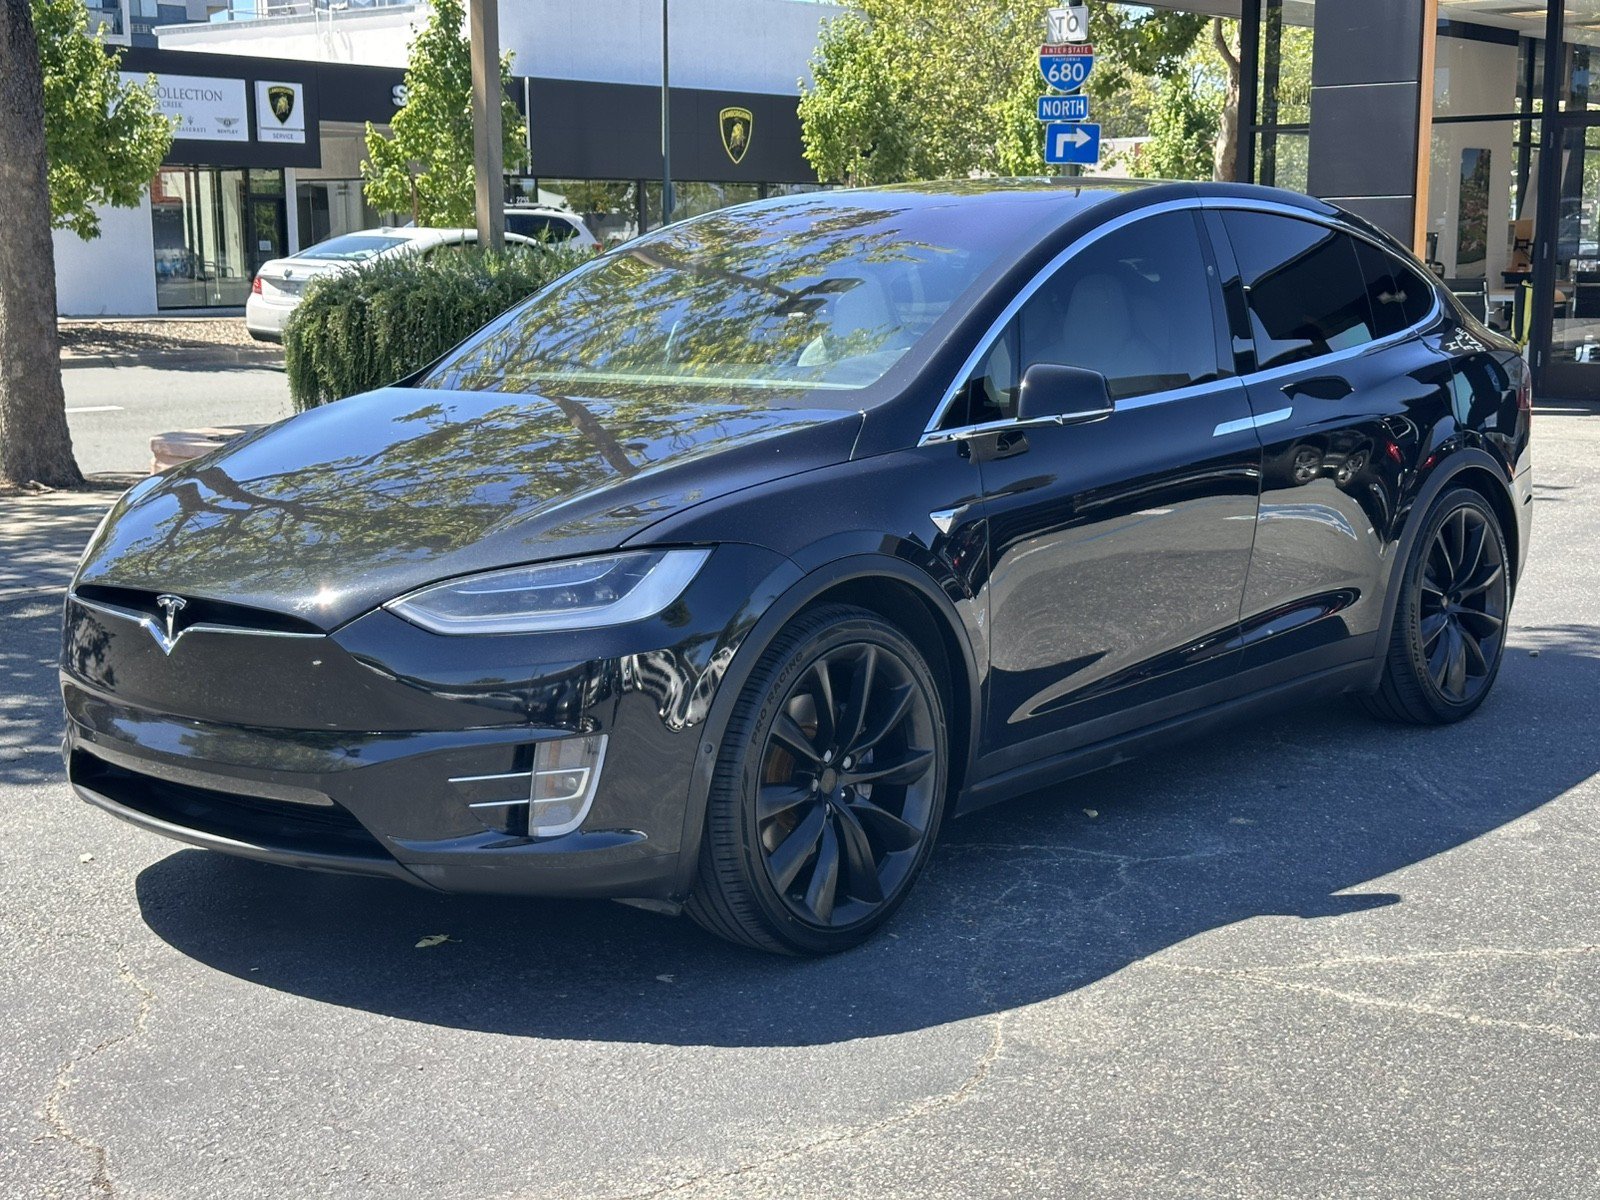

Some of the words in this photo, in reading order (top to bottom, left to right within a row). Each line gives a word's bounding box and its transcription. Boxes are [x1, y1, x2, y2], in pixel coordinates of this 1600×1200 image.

[1056, 15, 1079, 33] TO
[1045, 46, 1089, 54] INTERSTATE
[1048, 63, 1084, 82] 680
[1042, 100, 1084, 117] NORTH
[272, 132, 293, 140] SERVICE
[752, 707, 767, 745] PRO
[766, 651, 803, 705] RACING
